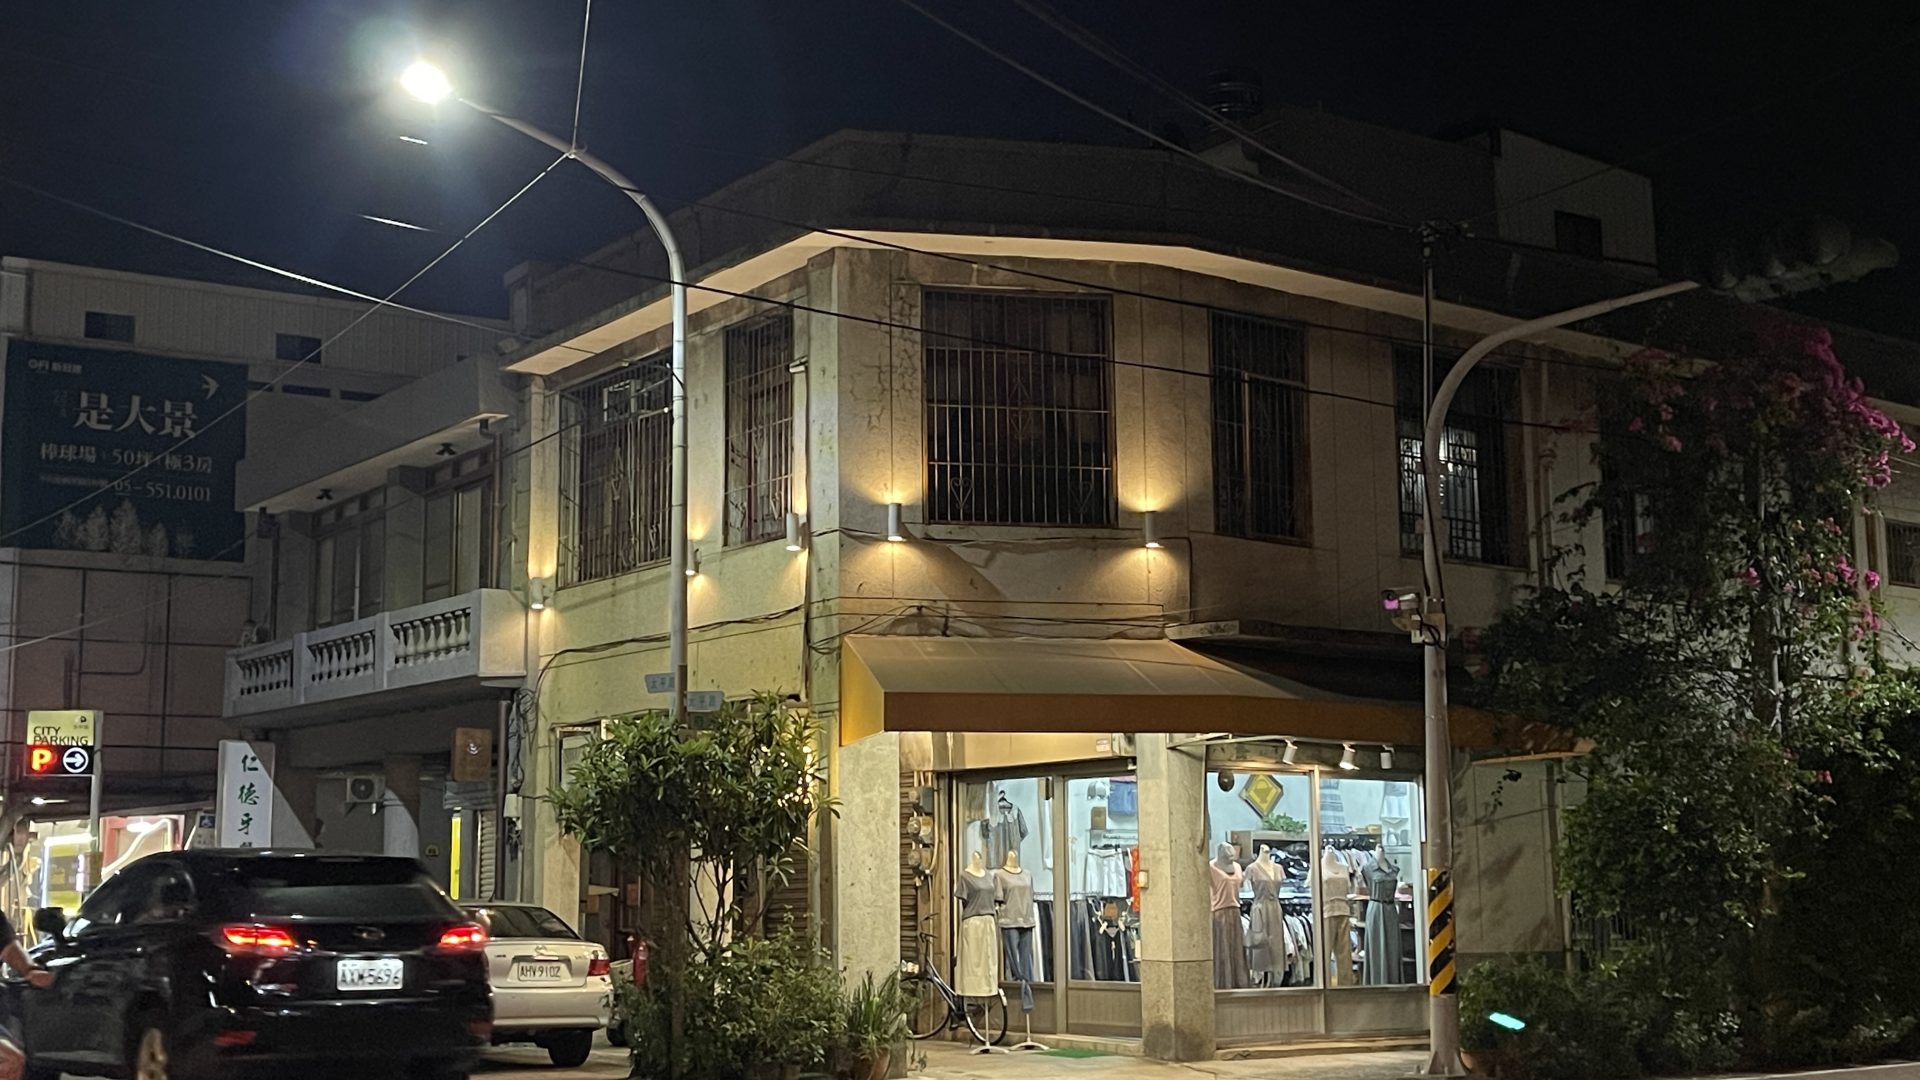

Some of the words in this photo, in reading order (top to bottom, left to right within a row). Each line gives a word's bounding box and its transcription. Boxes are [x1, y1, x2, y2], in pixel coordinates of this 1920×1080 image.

[73, 392, 198, 438] 是大景
[40, 442, 96, 463] 棒球場
[33, 726, 61, 735] CITY
[33, 736, 88, 746] PARKING
[31, 749, 52, 771] P
[237, 754, 260, 847] 仁德牙
